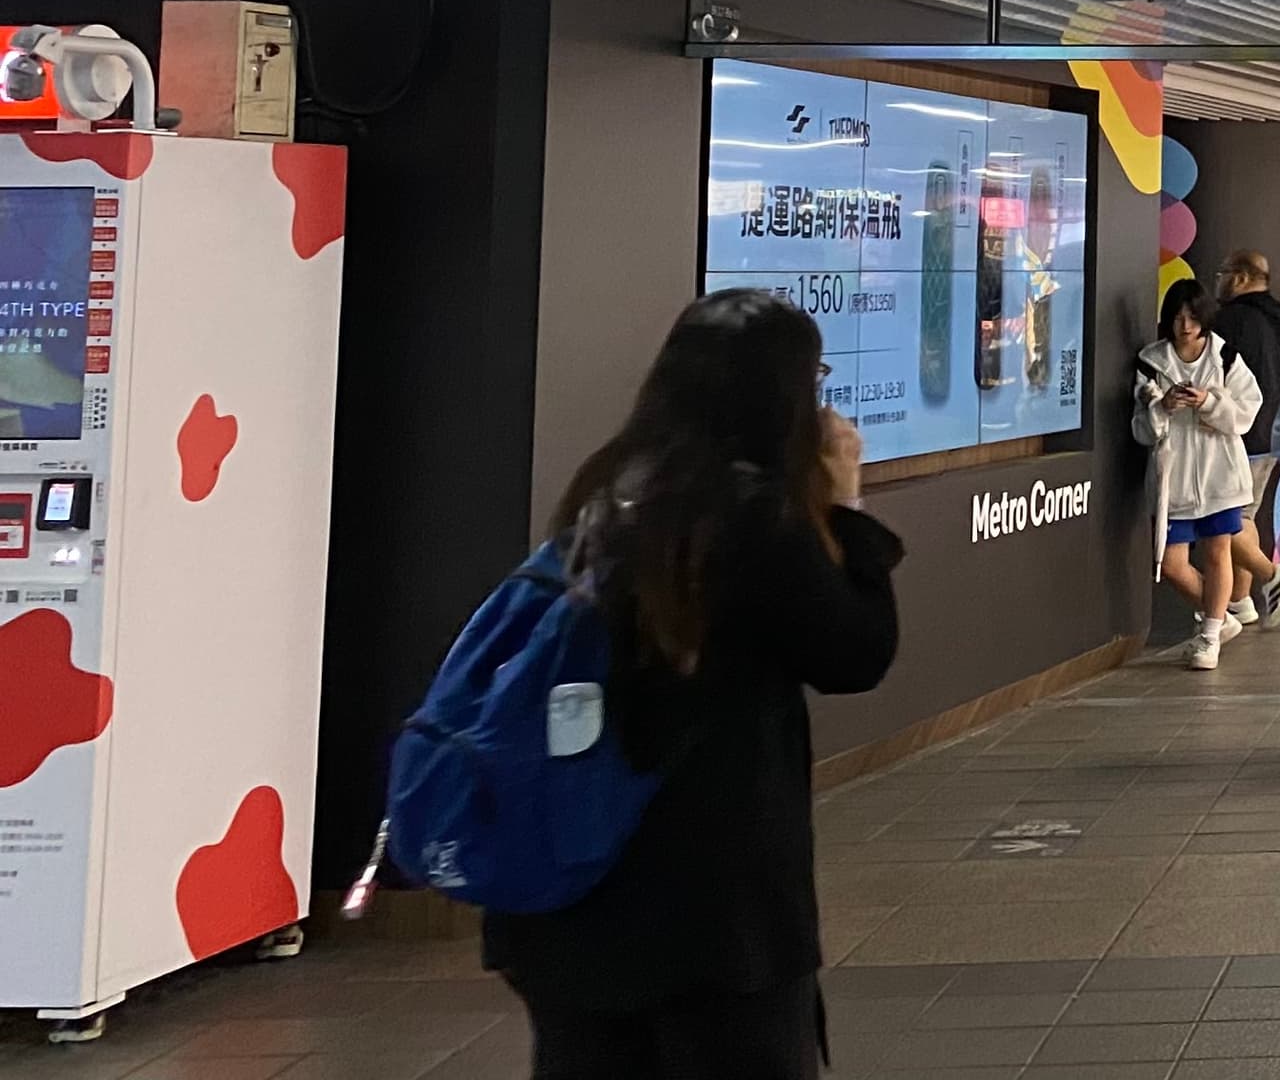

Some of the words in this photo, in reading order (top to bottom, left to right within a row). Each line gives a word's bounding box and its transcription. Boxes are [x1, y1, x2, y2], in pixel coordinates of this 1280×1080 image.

[40, 301, 86, 318] TYPE
[970, 489, 1027, 544] Metro
[1029, 478, 1092, 528] Corner
